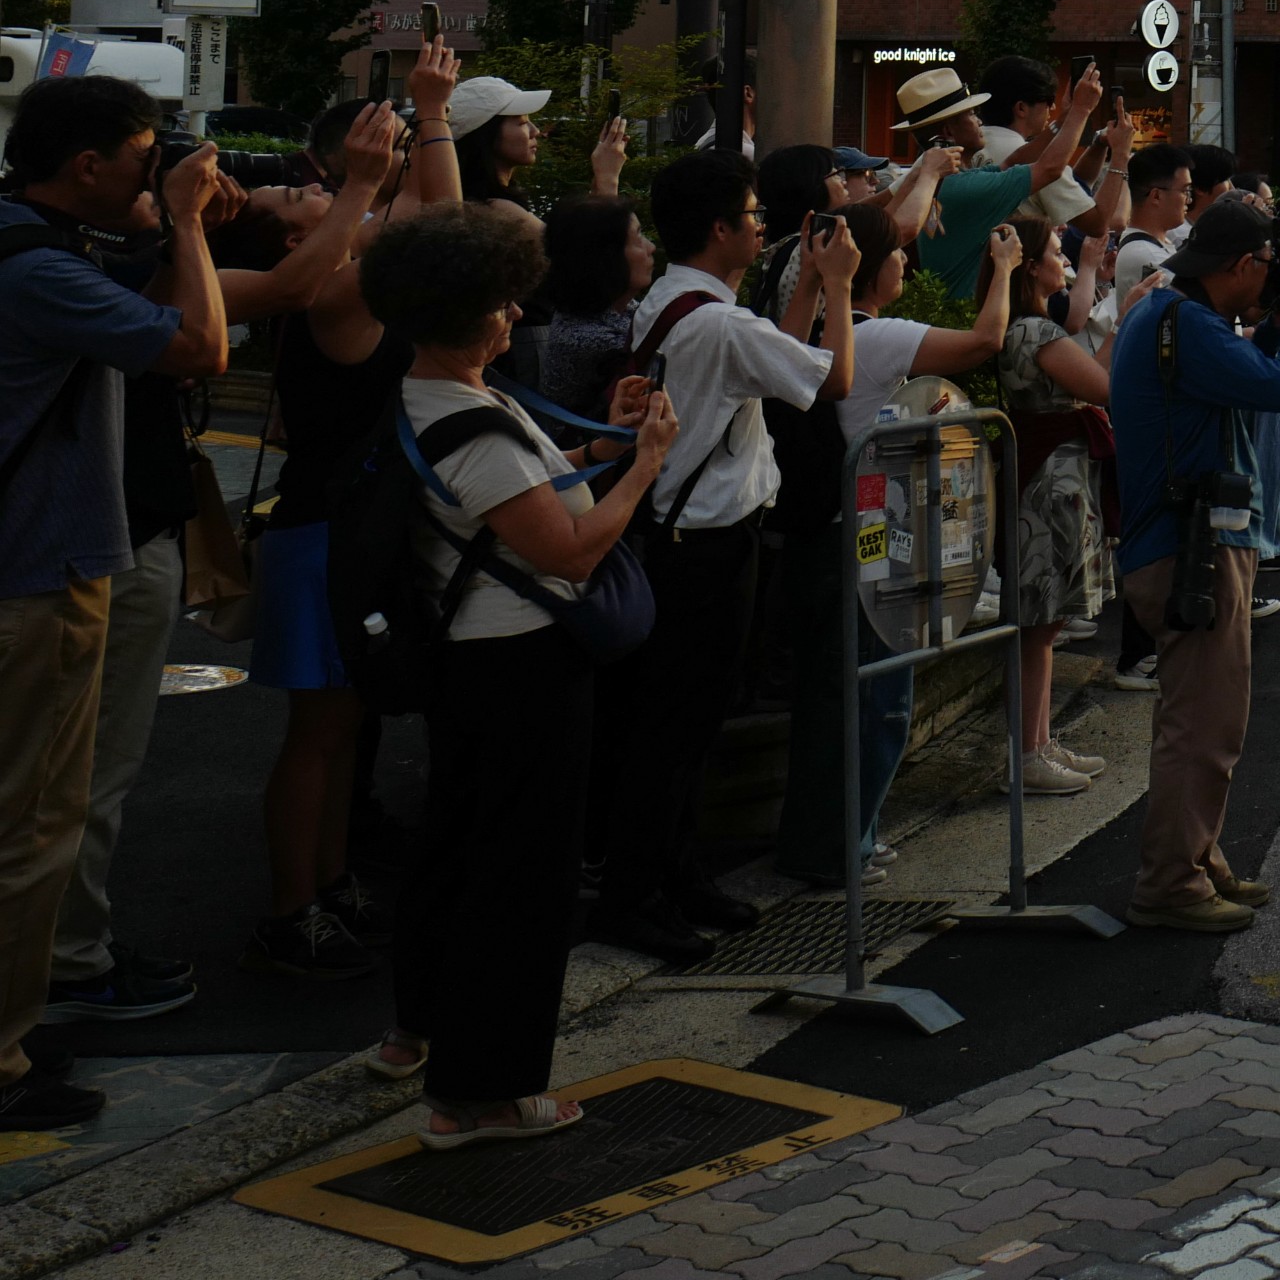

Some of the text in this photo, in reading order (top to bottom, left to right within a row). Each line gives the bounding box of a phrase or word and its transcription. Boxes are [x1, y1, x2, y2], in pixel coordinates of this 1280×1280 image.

[210, 21, 221, 64] ここまで
[189, 22, 203, 96] 法定駐停車禁止
[874, 47, 957, 64] good knight ice
[77, 224, 126, 243] Canon
[1162, 319, 1172, 345] NPS
[858, 529, 885, 547] KEST
[891, 530, 912, 548] RAY'S
[860, 543, 883, 560] GAK
